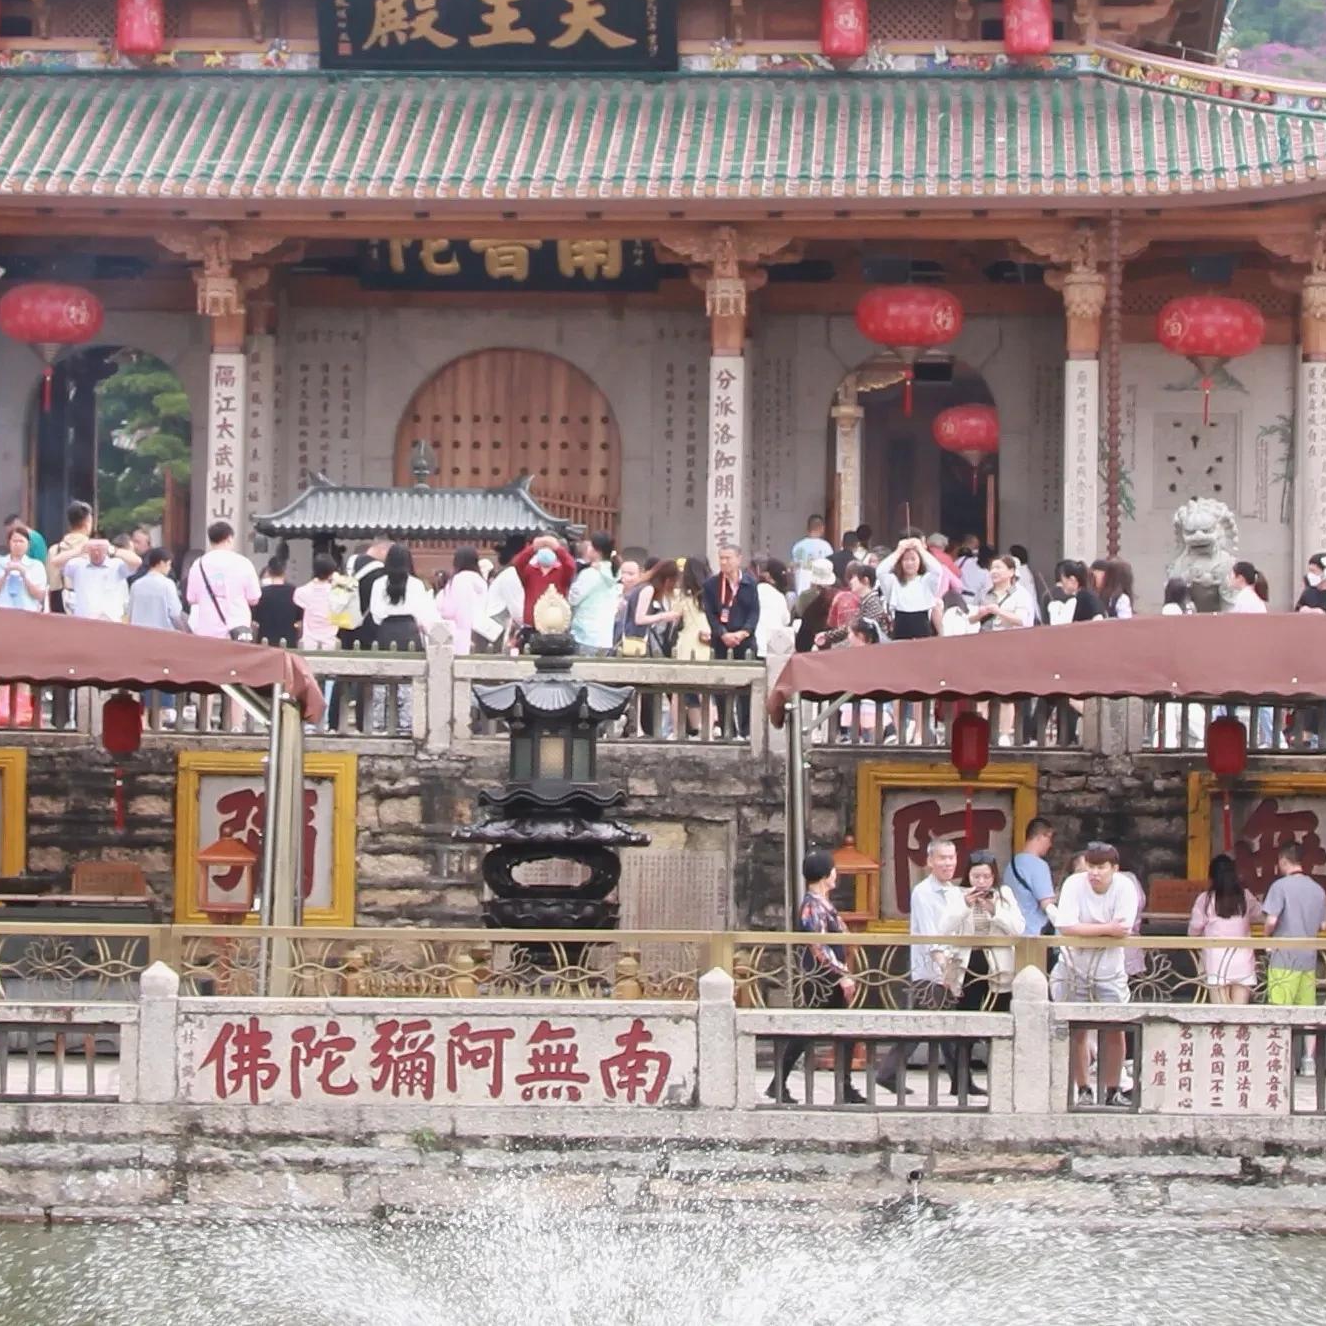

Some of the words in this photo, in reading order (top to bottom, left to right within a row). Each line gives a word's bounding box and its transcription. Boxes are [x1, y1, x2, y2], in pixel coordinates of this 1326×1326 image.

[196, 1016, 673, 1105] 南無阿彌陀佛
